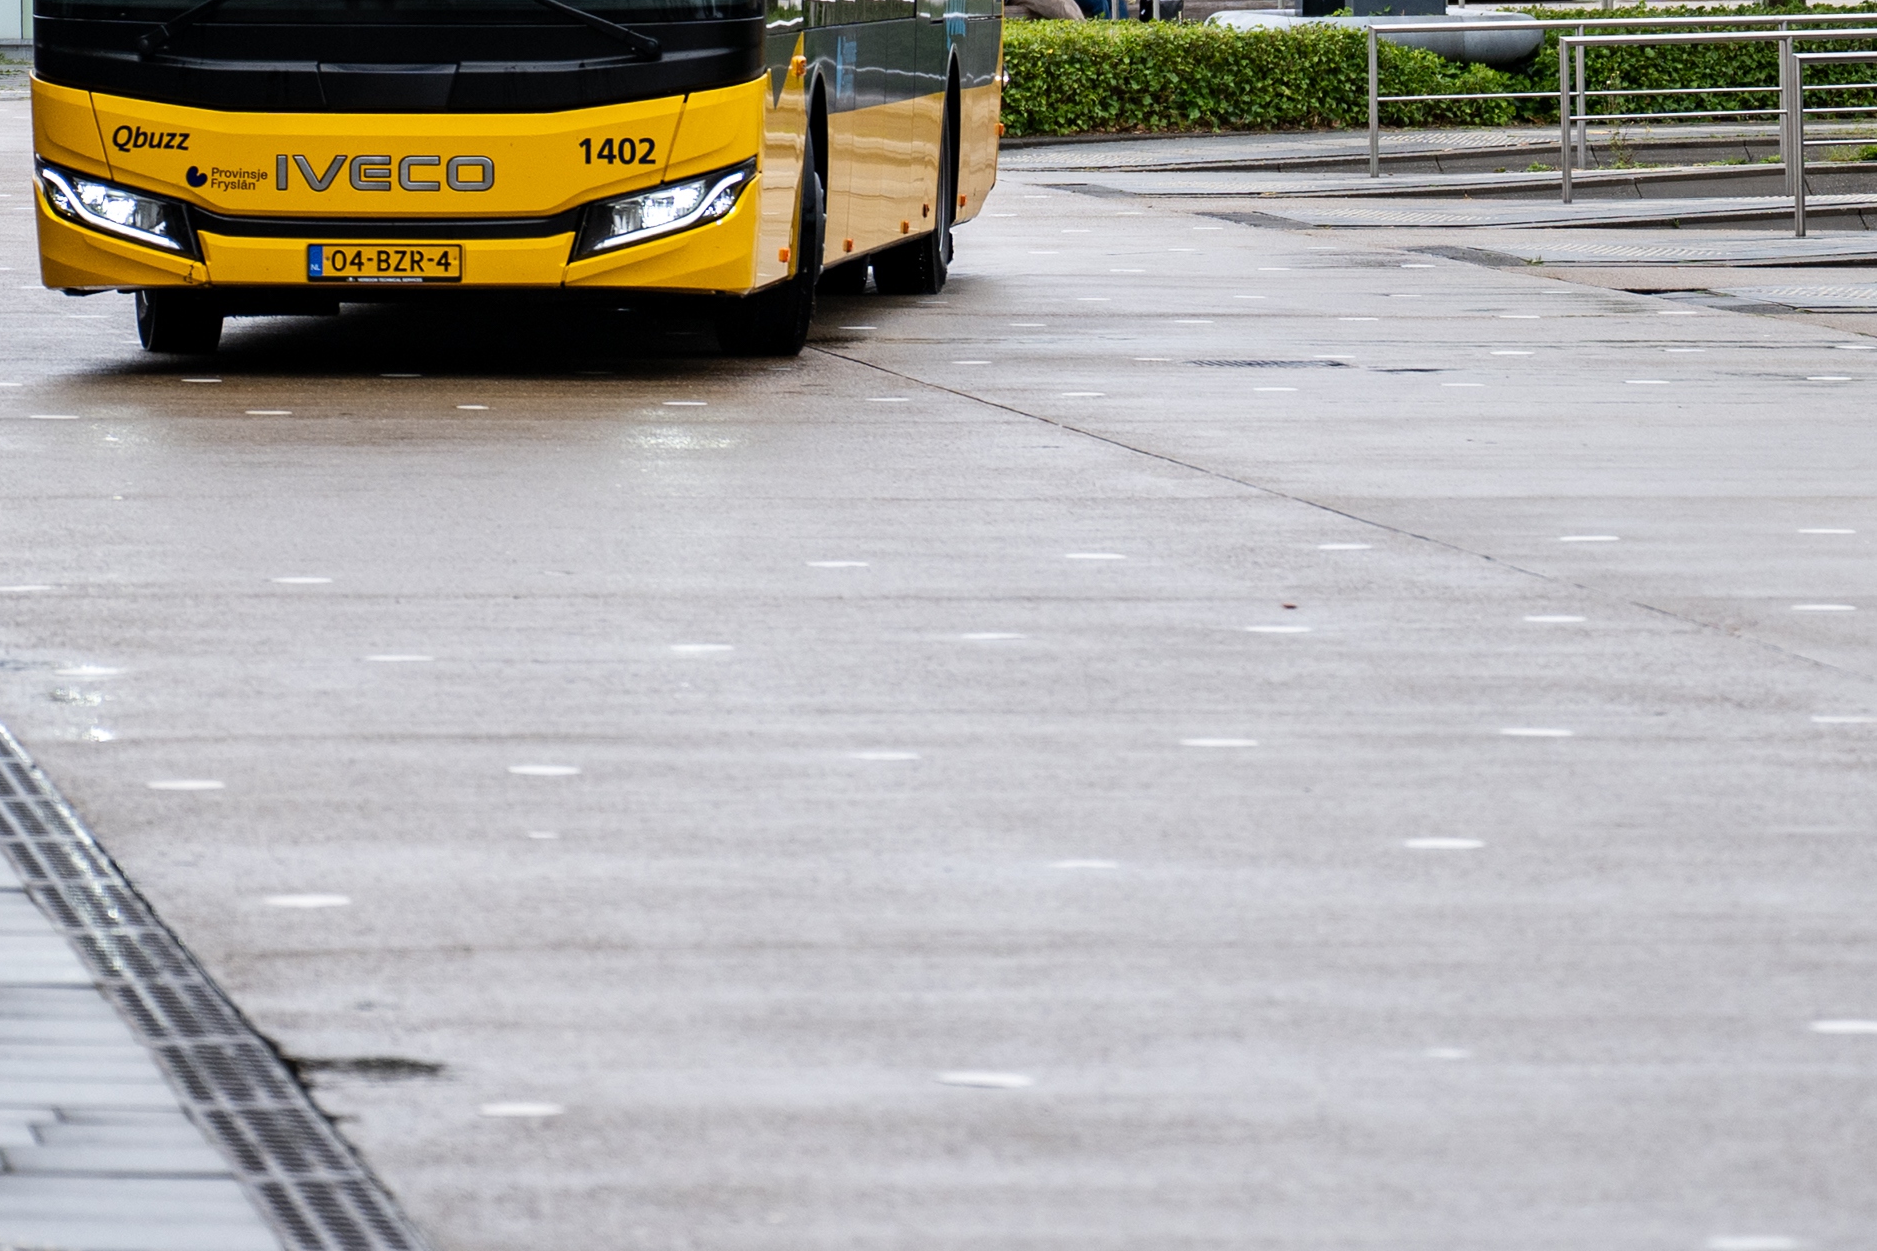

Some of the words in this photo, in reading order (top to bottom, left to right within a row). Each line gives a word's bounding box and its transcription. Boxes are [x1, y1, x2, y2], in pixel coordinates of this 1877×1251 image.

[112, 125, 190, 153] Qbuzz
[579, 137, 656, 165] 1402
[211, 167, 268, 182] Provinsje
[211, 178, 256, 192] Fryslân
[276, 154, 495, 192] IVECO
[310, 263, 321, 271] NL
[331, 249, 452, 272] 04-BZR-4
